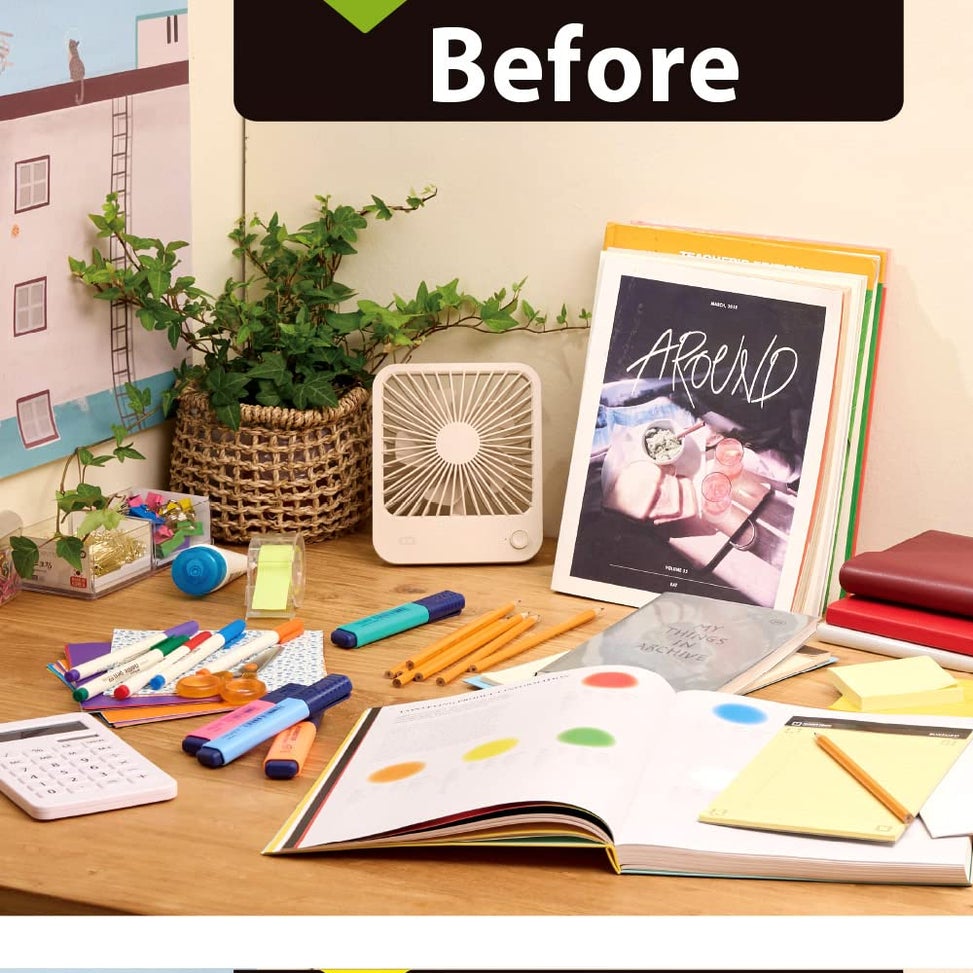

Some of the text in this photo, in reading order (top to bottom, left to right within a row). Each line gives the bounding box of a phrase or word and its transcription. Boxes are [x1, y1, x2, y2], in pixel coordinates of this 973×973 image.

[626, 328, 799, 409] AROUND
[666, 626, 729, 645] THINGS
[699, 623, 726, 631] MY
[635, 642, 709, 662] ARCHIVE
[673, 639, 695, 649] IN
